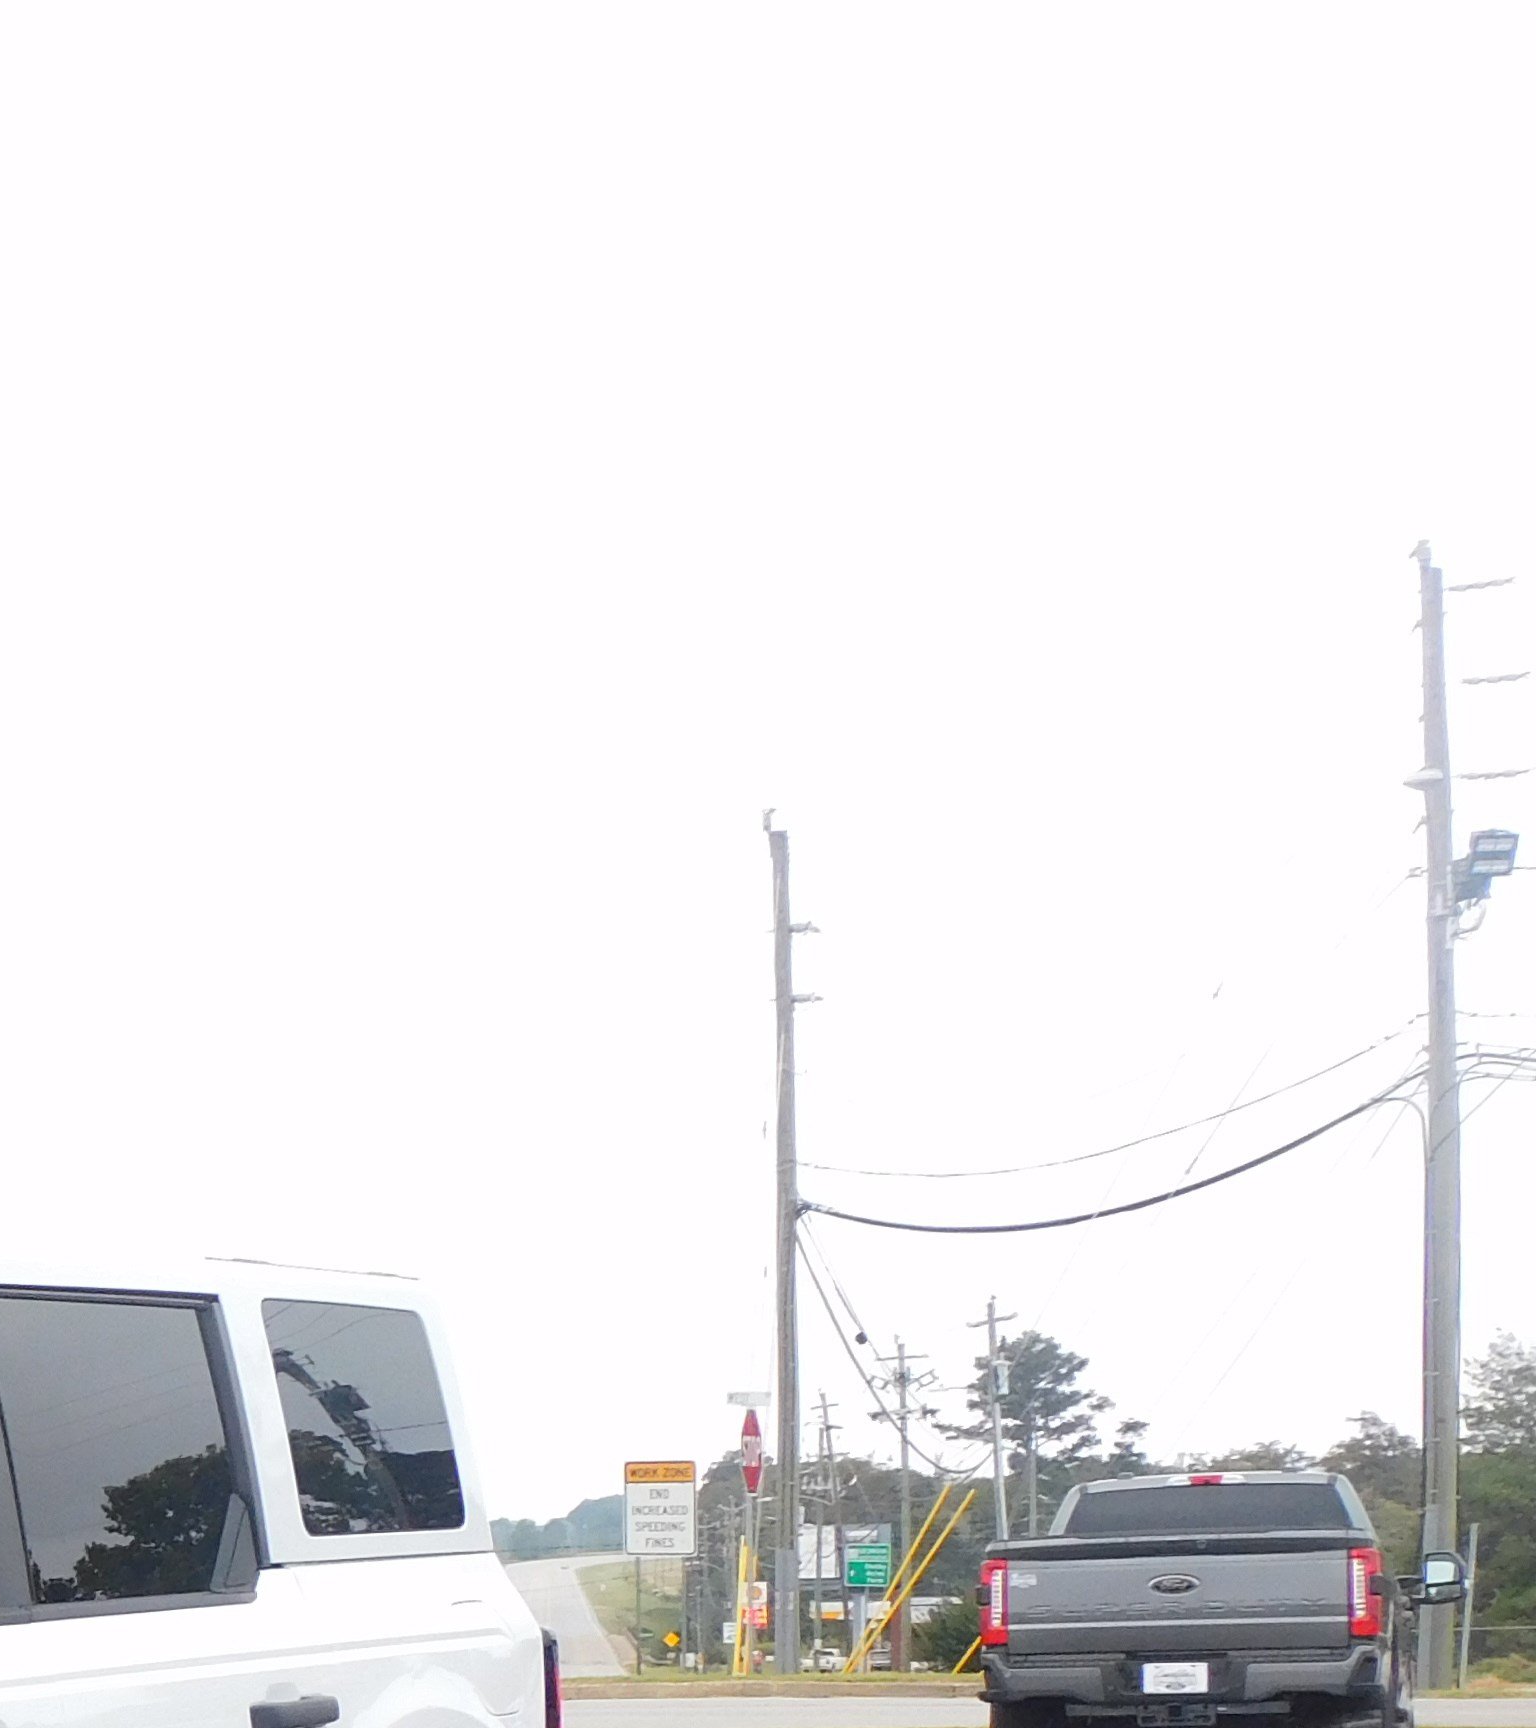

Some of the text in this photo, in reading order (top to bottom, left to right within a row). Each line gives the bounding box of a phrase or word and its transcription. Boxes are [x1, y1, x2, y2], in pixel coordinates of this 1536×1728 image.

[630, 1467, 692, 1478] WORK ZONE
[649, 1488, 670, 1499] END
[631, 1505, 689, 1516] INCREASED
[634, 1521, 686, 1532] SPEEDING
[645, 1537, 675, 1548] FINES
